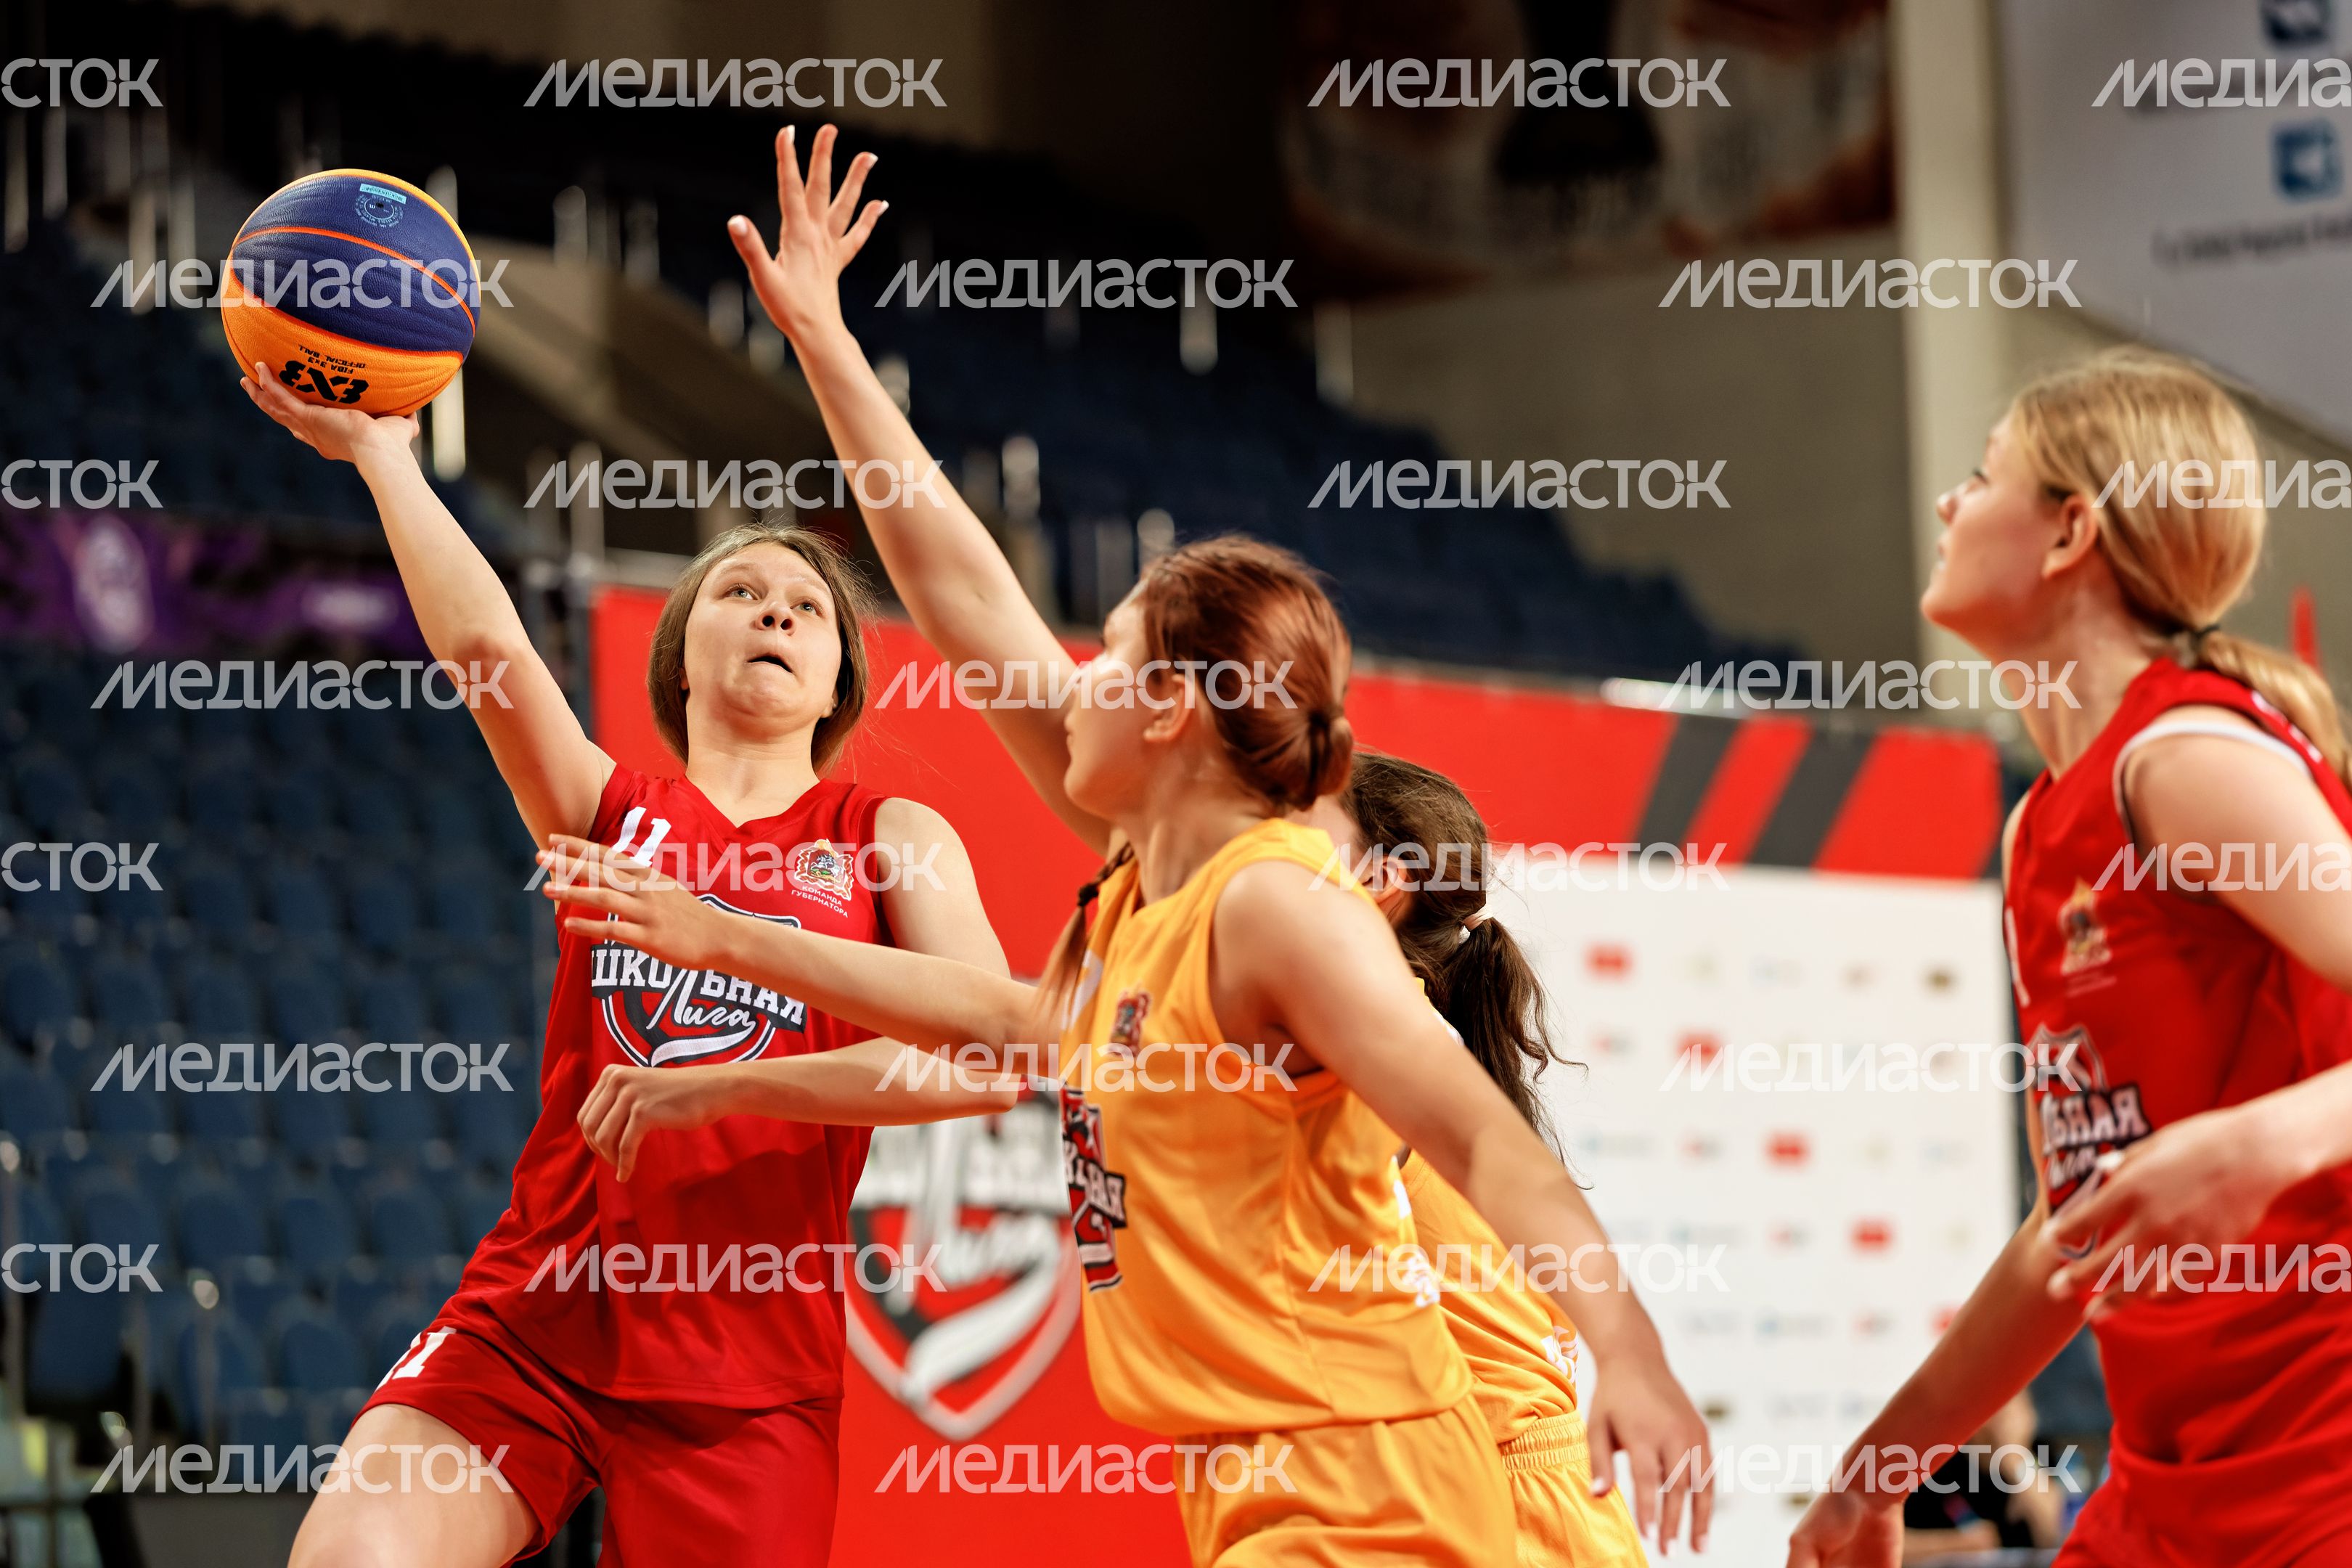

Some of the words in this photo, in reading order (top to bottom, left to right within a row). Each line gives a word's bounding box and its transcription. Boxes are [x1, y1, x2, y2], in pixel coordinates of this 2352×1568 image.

[298, 343, 320, 359] BALL
[324, 354, 366, 369] OFFICIAL
[330, 364, 354, 375] FIBA
[611, 806, 671, 867] 11
[791, 889, 849, 918] ГУБЕРНАТОРА
[801, 885, 843, 907] КОМАНДА
